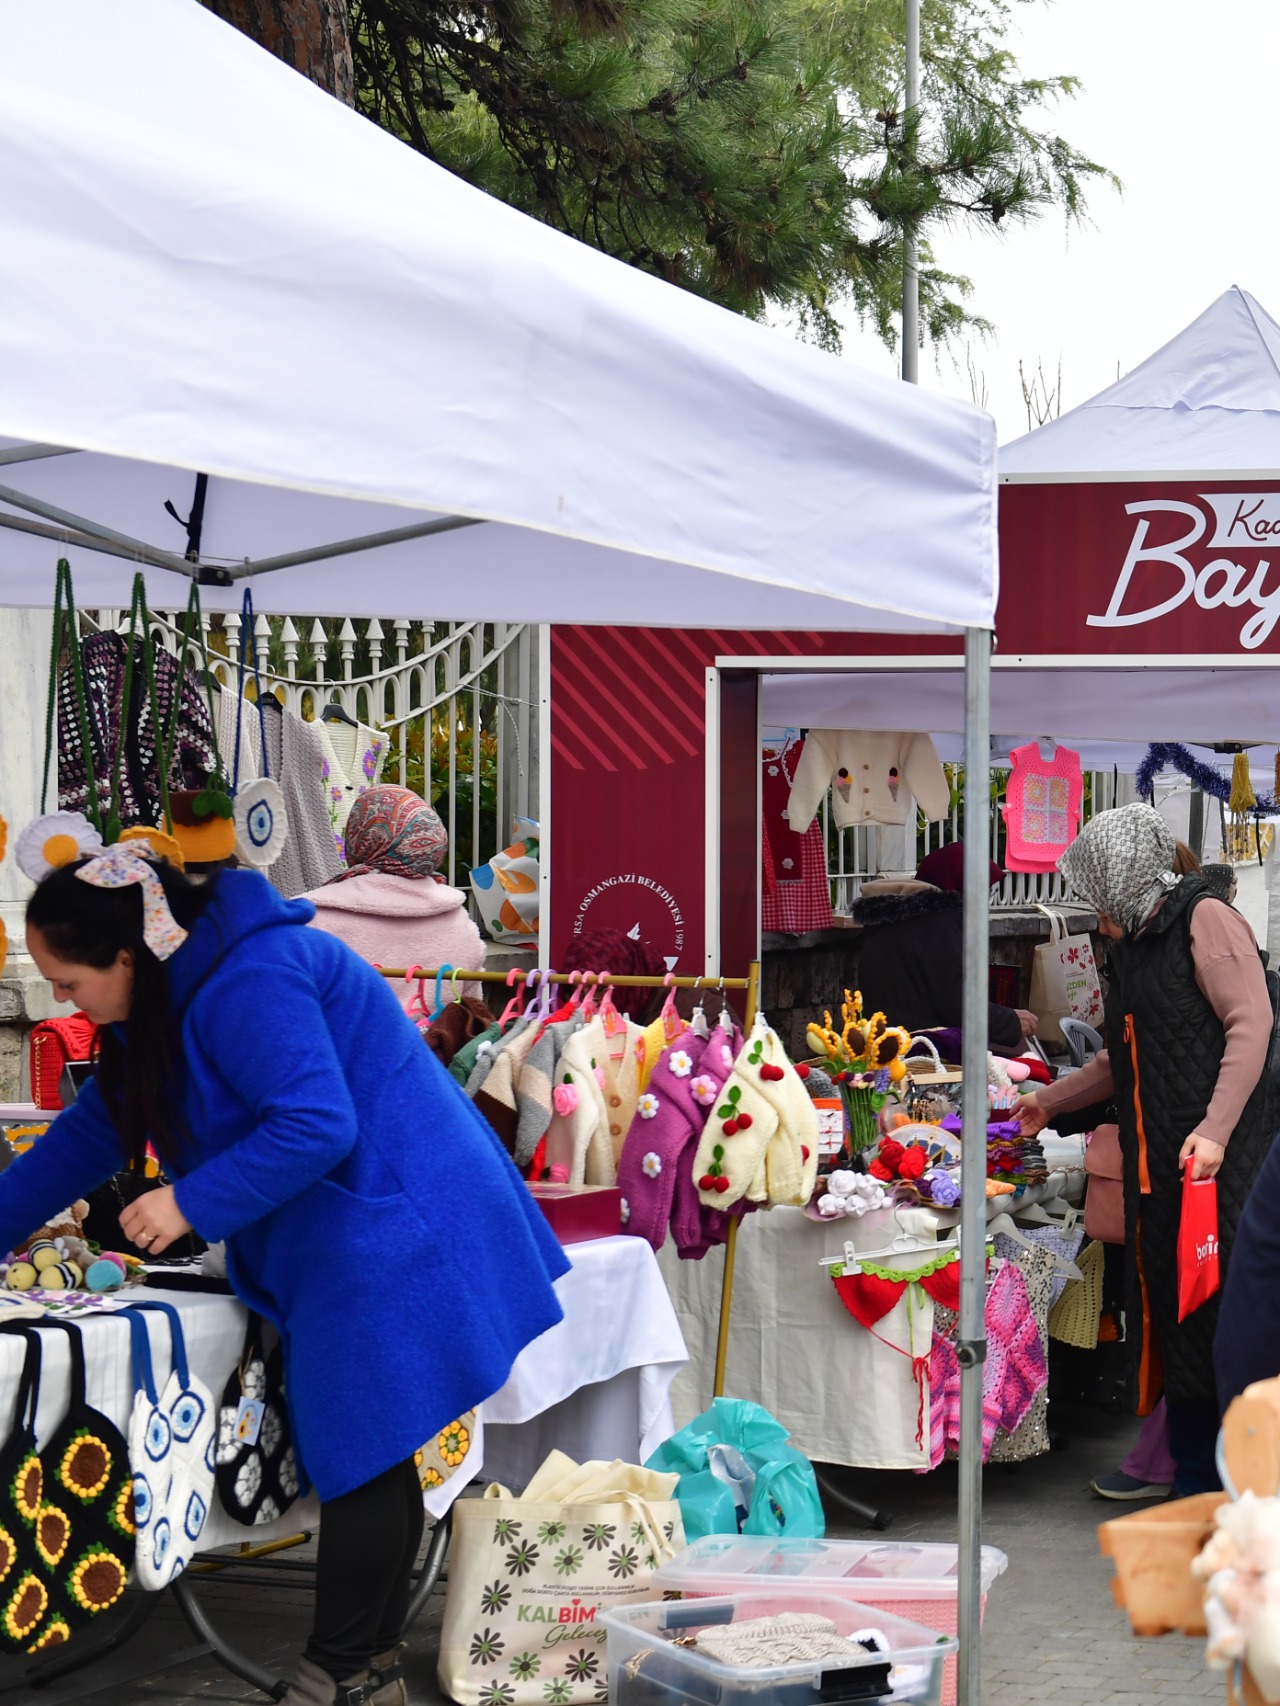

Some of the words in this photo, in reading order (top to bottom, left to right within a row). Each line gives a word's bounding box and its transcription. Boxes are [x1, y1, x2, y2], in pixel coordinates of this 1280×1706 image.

[573, 914, 585, 938] RSA
[579, 872, 636, 911] OSMANGAZİ
[637, 875, 685, 926] BELEDİYESİ
[674, 929, 684, 951] 1987
[517, 1599, 603, 1624] KALBİM
